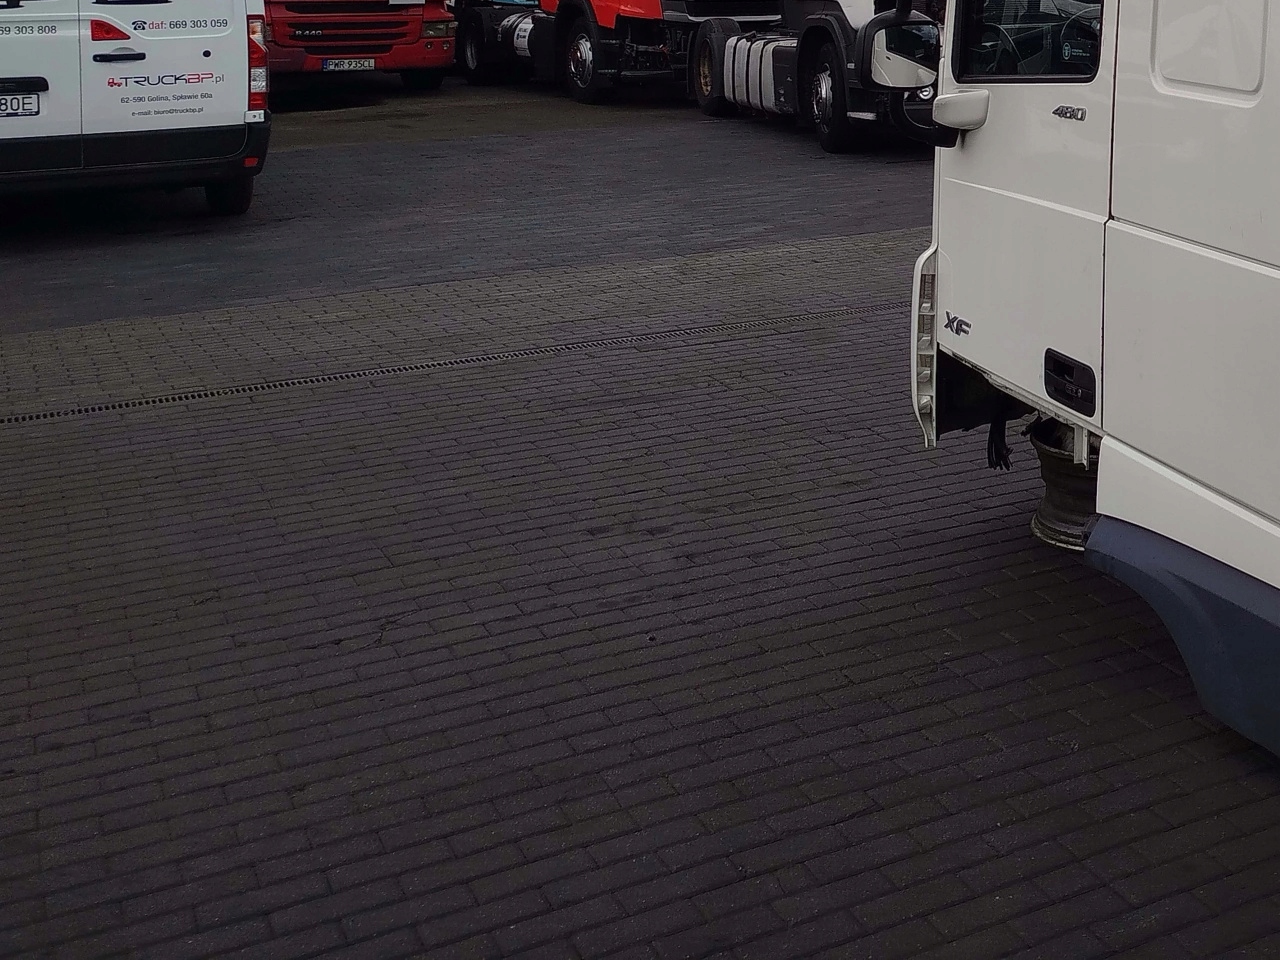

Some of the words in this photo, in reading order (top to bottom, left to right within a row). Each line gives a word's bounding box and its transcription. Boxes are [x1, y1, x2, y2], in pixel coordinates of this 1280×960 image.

[148, 21, 167, 30] daf:
[169, 20, 187, 29] 669
[190, 20, 208, 29] 303
[210, 19, 228, 28] 059
[14, 26, 34, 35] 303
[37, 25, 57, 34] 808
[328, 61, 345, 69] PWR
[944, 311, 972, 337] XF
